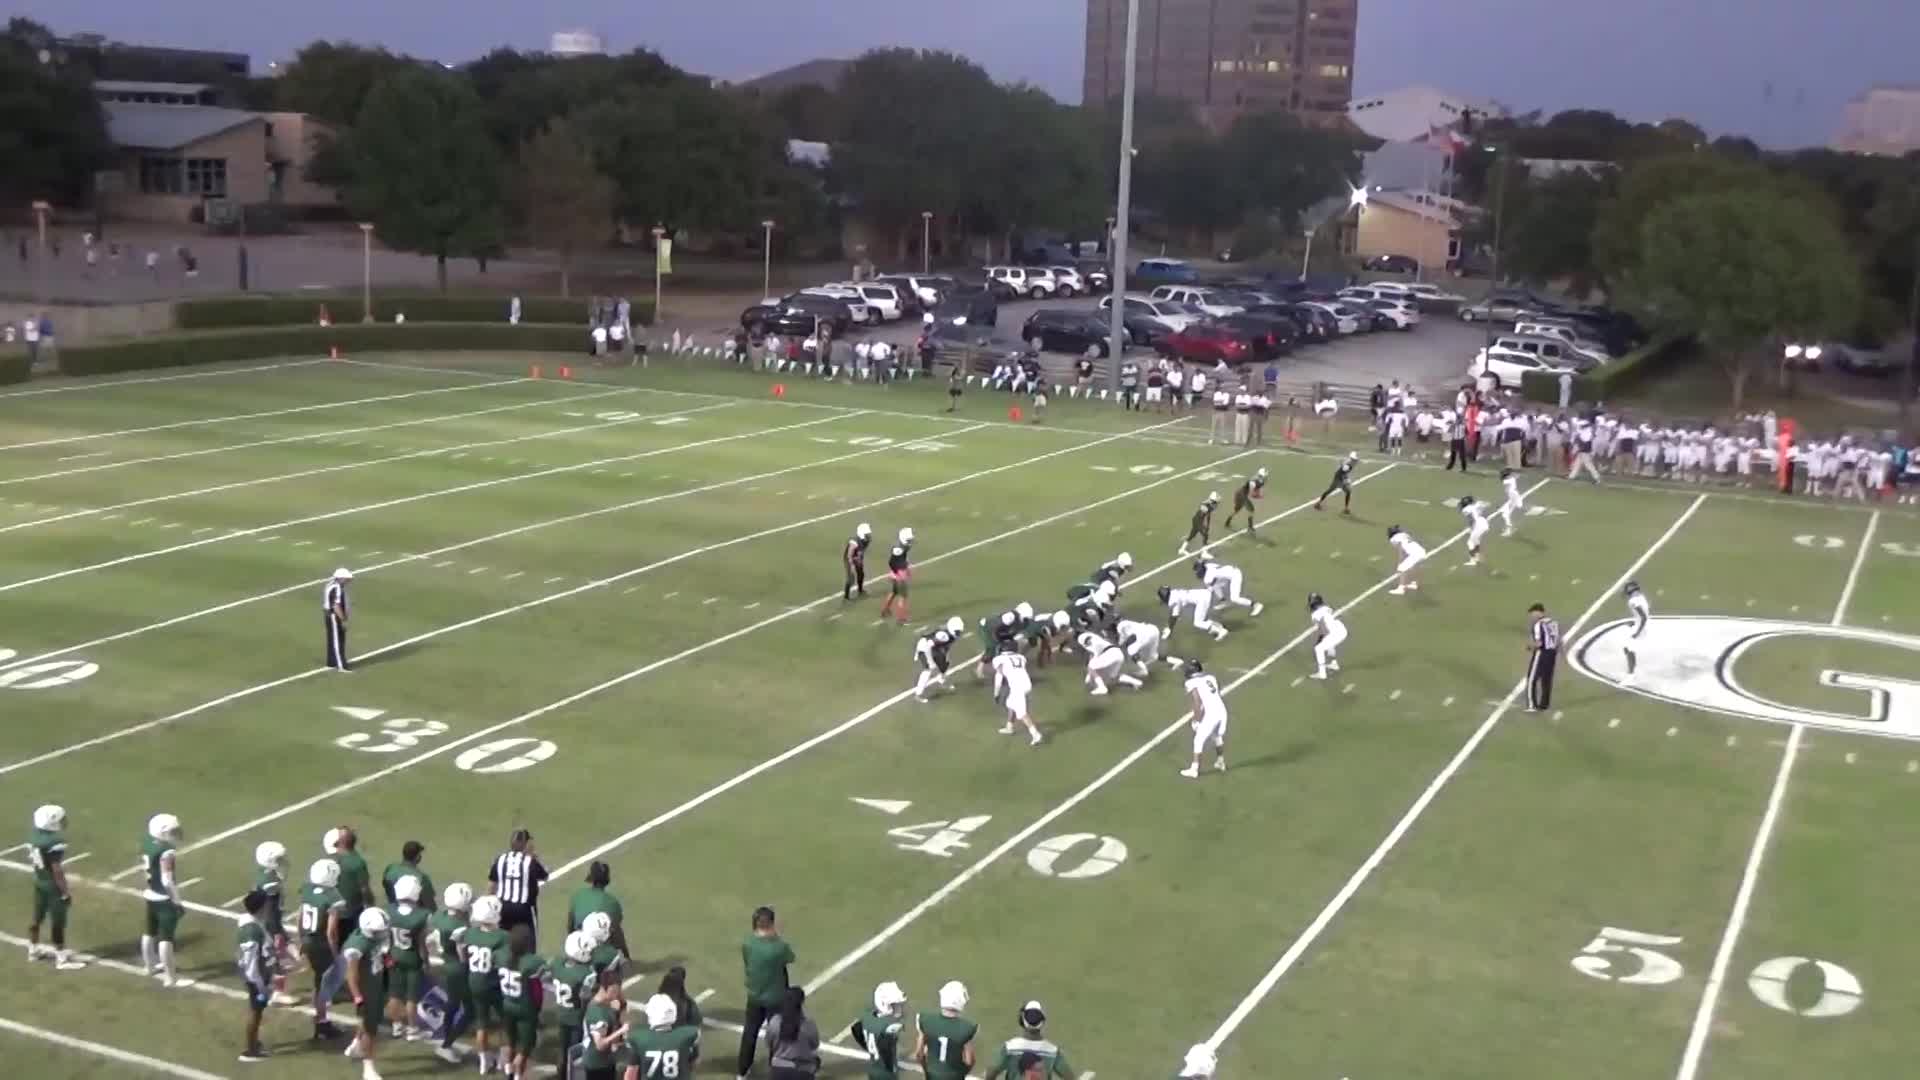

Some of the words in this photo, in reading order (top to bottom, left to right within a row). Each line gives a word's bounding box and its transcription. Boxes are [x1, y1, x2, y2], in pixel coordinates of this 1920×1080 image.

[467, 944, 492, 973] 28
[498, 966, 523, 997] 25
[937, 1035, 949, 1062] 1
[644, 1050, 680, 1078] 78
